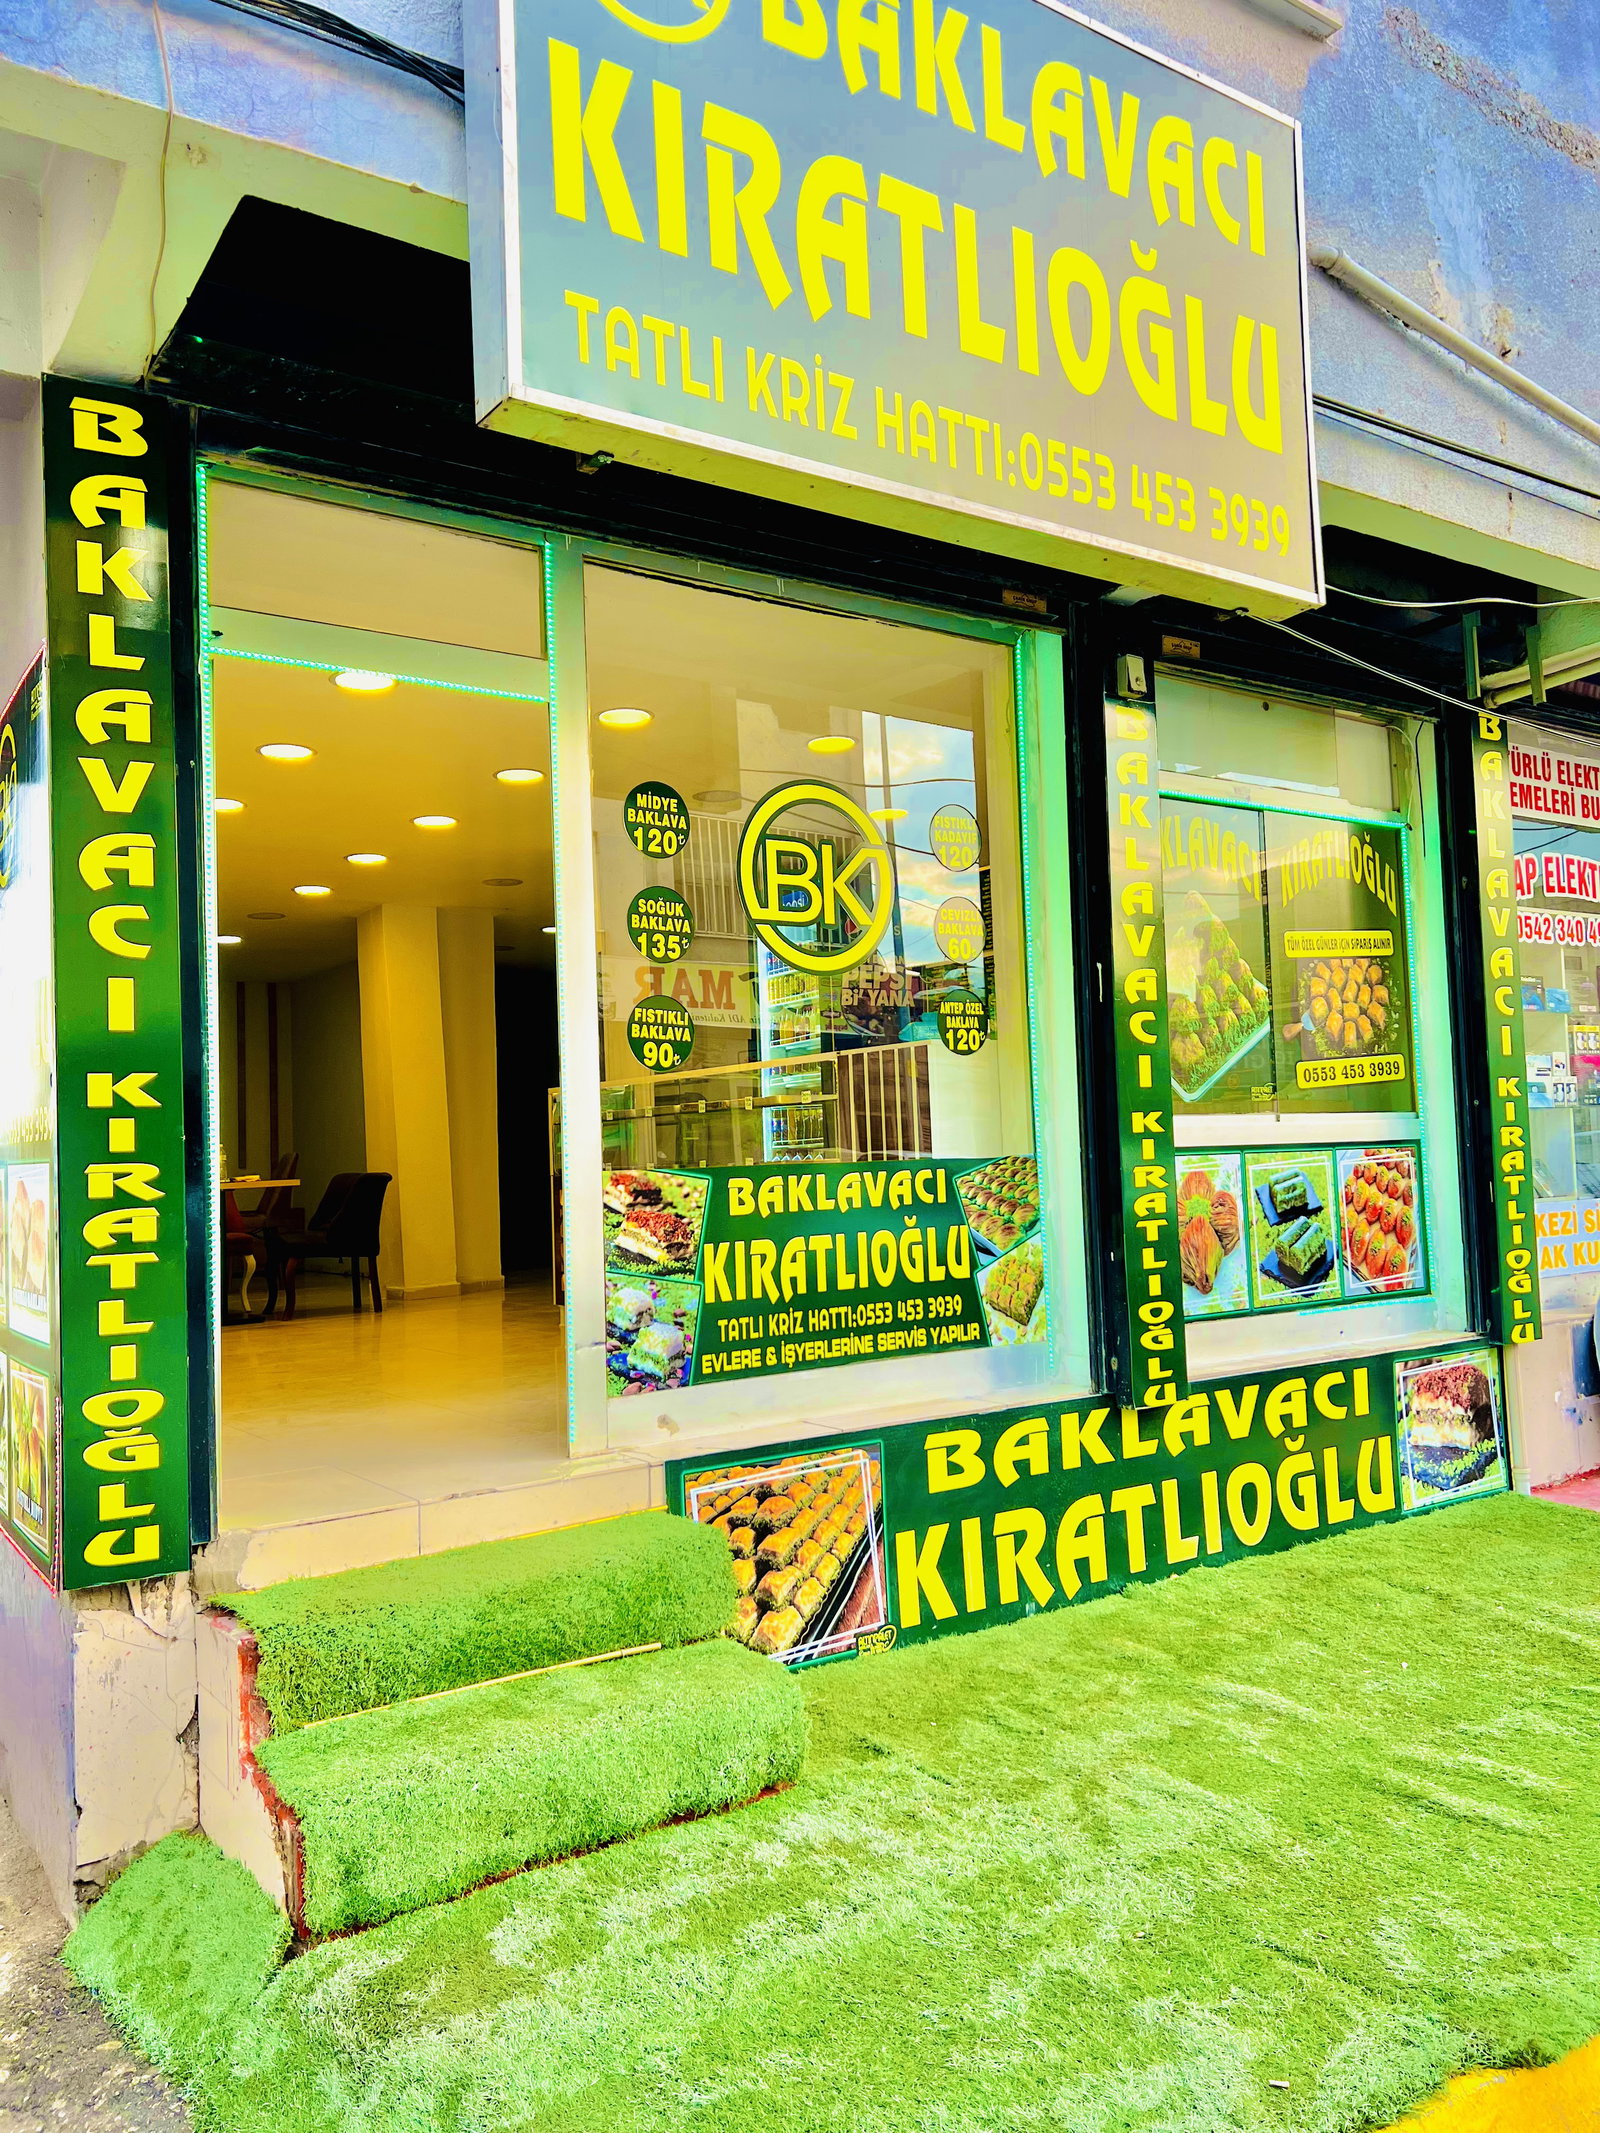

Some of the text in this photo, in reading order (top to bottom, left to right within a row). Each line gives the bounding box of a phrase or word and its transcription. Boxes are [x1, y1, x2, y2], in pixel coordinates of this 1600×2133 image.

[548, 38, 1284, 455] KIRATLIOĞLU
[565, 290, 1291, 557] TATLI KRİZ HATTI:0553 453 3939
[1508, 745, 1600, 792] ÜRLÜ ELEKT
[636, 790, 678, 812] MİDYE
[1510, 781, 1600, 821] EMELERİ BU
[627, 808, 688, 831] BAKLAVA
[934, 829, 978, 845] KADAYIF
[938, 845, 977, 868] 120
[765, 838, 874, 926] BK
[1280, 831, 1398, 918] KIRATLIOĞLU
[637, 896, 685, 918] SOĞUK
[631, 914, 692, 936] BAKLAVA
[938, 922, 984, 937] BAKLAVA
[1516, 915, 1600, 944] 0542 340 4
[1287, 936, 1301, 951] TÜM
[1302, 936, 1316, 951] ÖZEL
[69, 396, 165, 1567] BAKLAVACI KIRATLIOĞLU
[867, 989, 915, 1007] YANA
[634, 1007, 690, 1027] FISTIKLI
[940, 999, 984, 1015] ANTEP ÖZEL
[946, 1015, 980, 1029] BAKLAVA
[631, 1023, 692, 1043] BAKLAVA
[1478, 711, 1536, 1345] BAKLAVACI KIRATLIOĞLU
[1115, 705, 1177, 1409] BAKLAVACI KIRATLIOĞLU
[1303, 1060, 1400, 1083] 0553 453 3939
[728, 1167, 947, 1218] BAKLAVACI
[703, 1215, 971, 1304] KIRATLIOĞLU
[718, 1293, 962, 1342] TATLI KRİZ HATTI:0553 453 3939
[701, 1322, 981, 1375] EVLERE & İŞYERLERİNE SERVİS YAPILIR
[924, 1366, 1371, 1495] BAKLAVACI
[894, 1433, 1397, 1630] KIRATLIOĞLU
